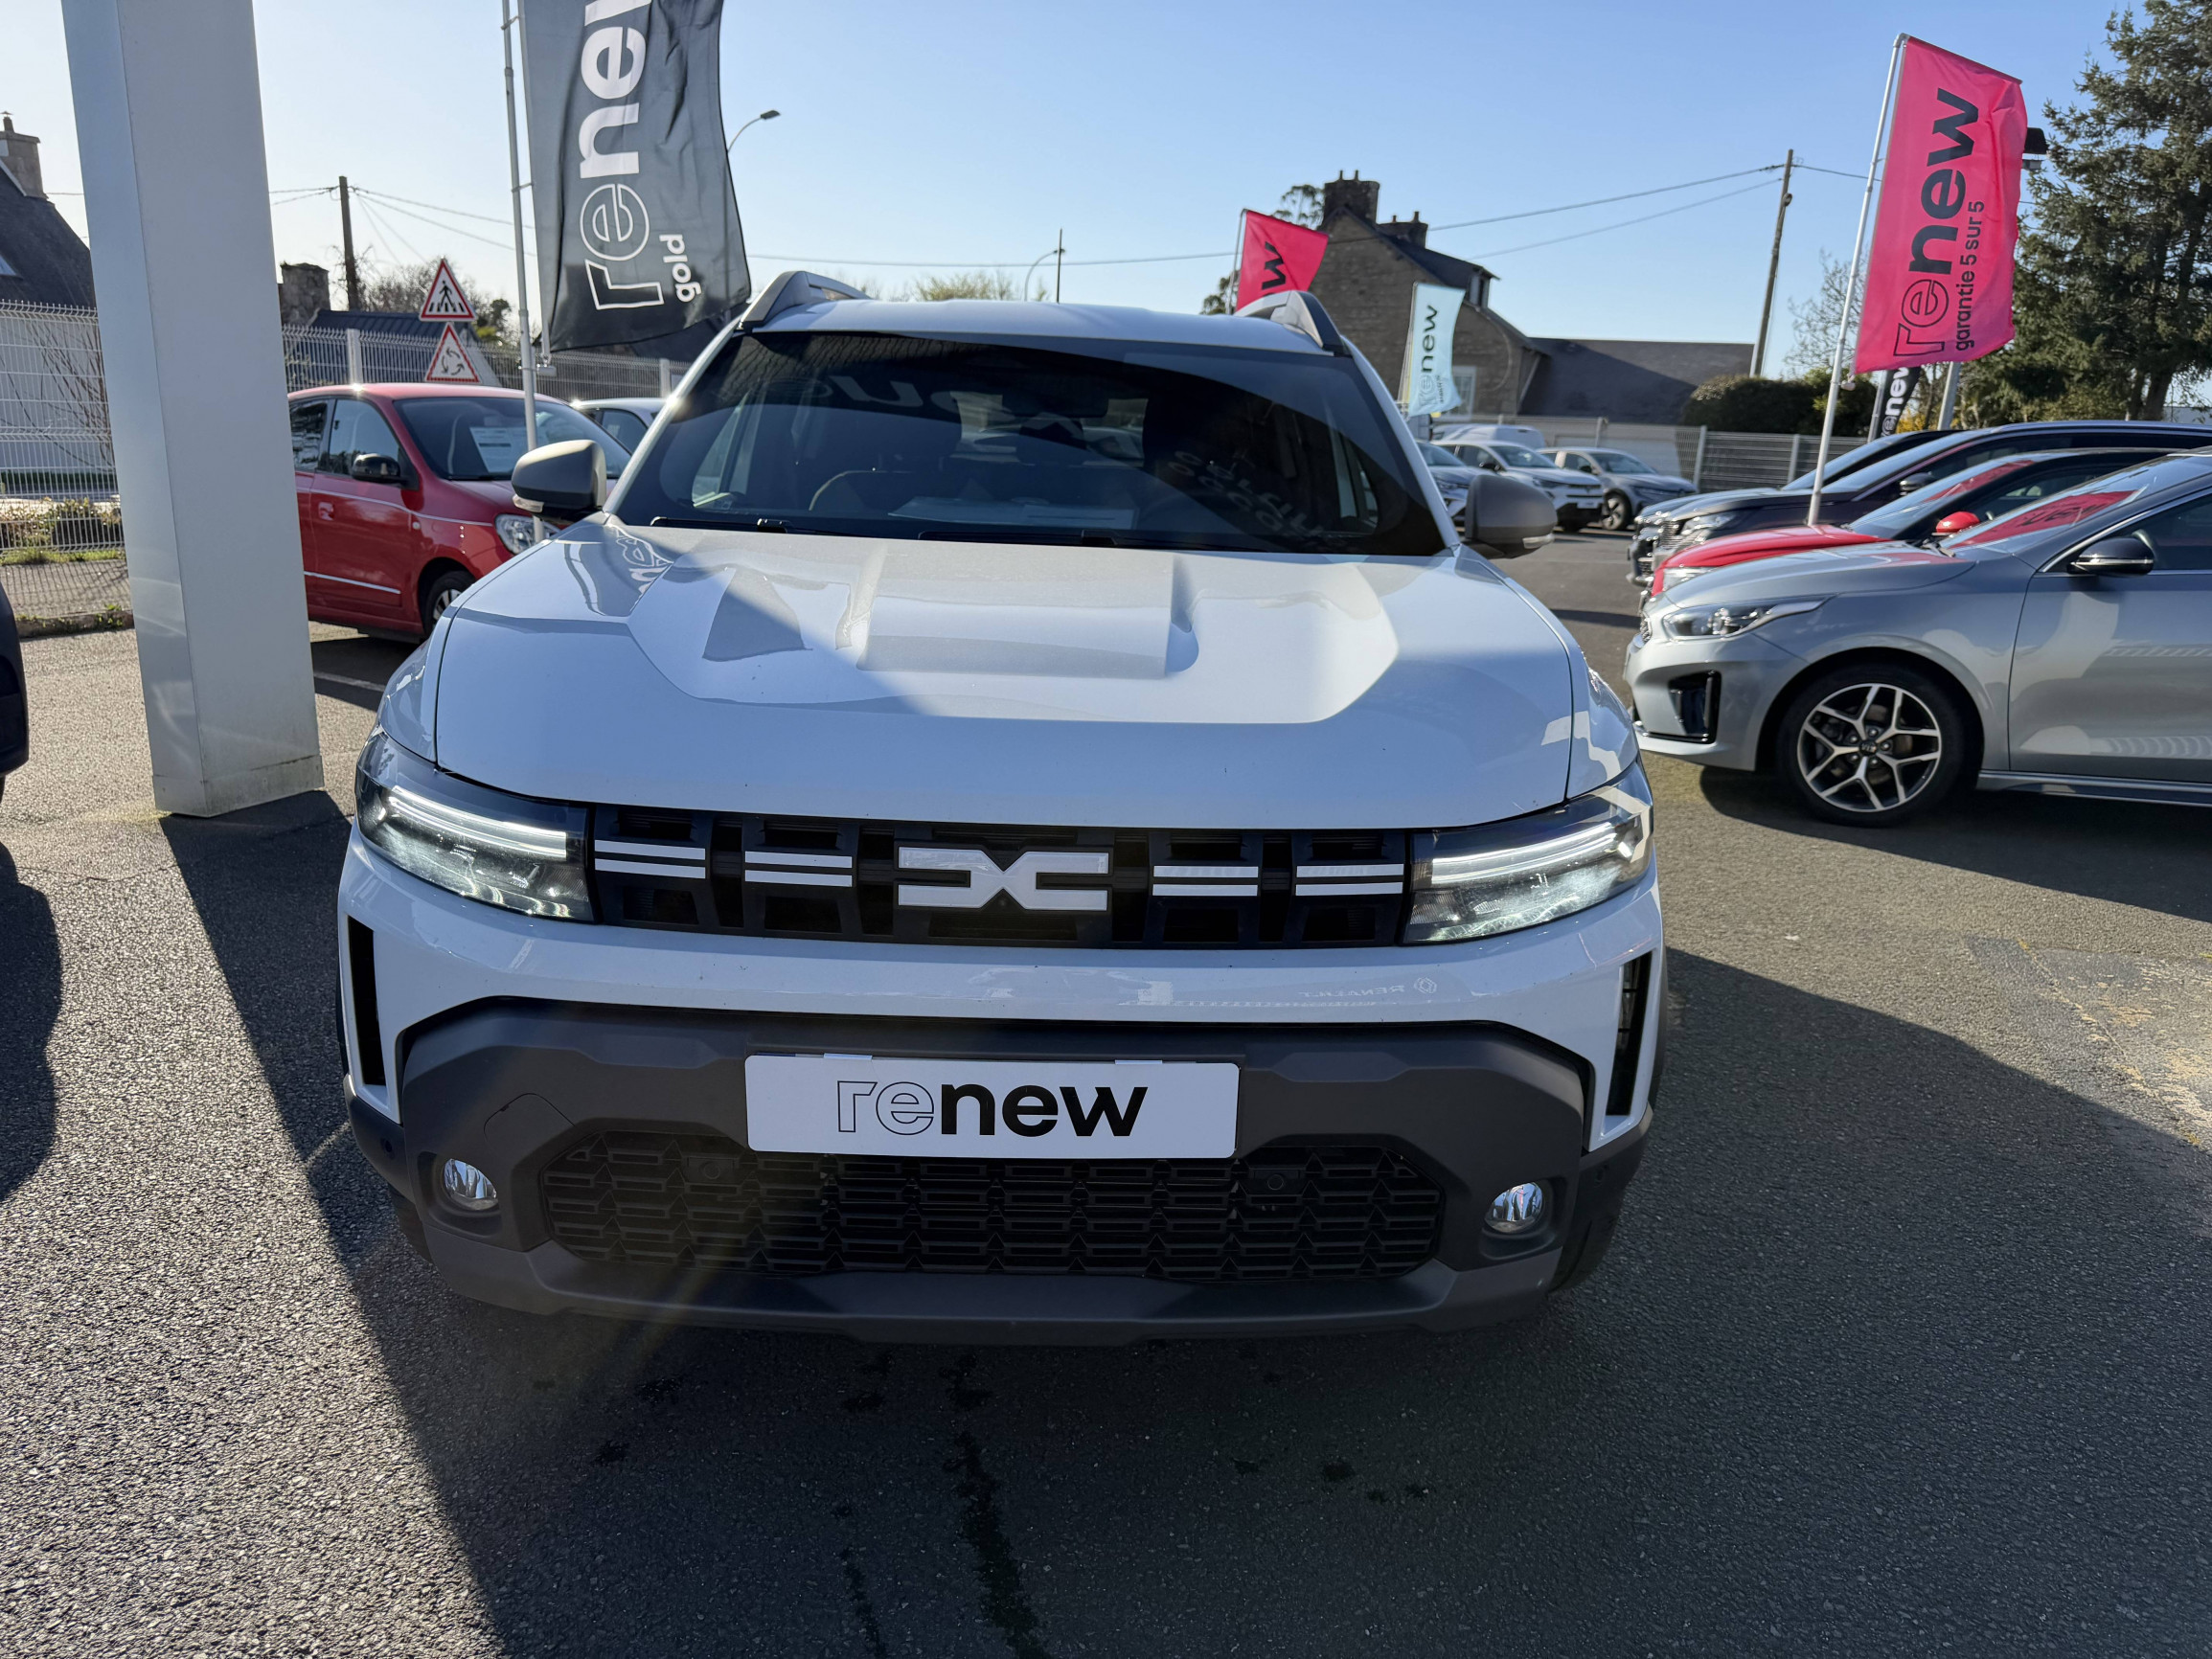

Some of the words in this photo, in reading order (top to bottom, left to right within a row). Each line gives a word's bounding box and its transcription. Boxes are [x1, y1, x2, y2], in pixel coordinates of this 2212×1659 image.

[579, 0, 665, 310] rene
[1893, 87, 1979, 357] renew
[1965, 219, 1982, 250] sur
[1968, 200, 1985, 213] 5
[659, 234, 702, 304] gold
[1959, 254, 1977, 265] 5
[1955, 270, 1975, 352] garantie
[1881, 367, 1909, 437] ene
[837, 1079, 1149, 1138] renew
